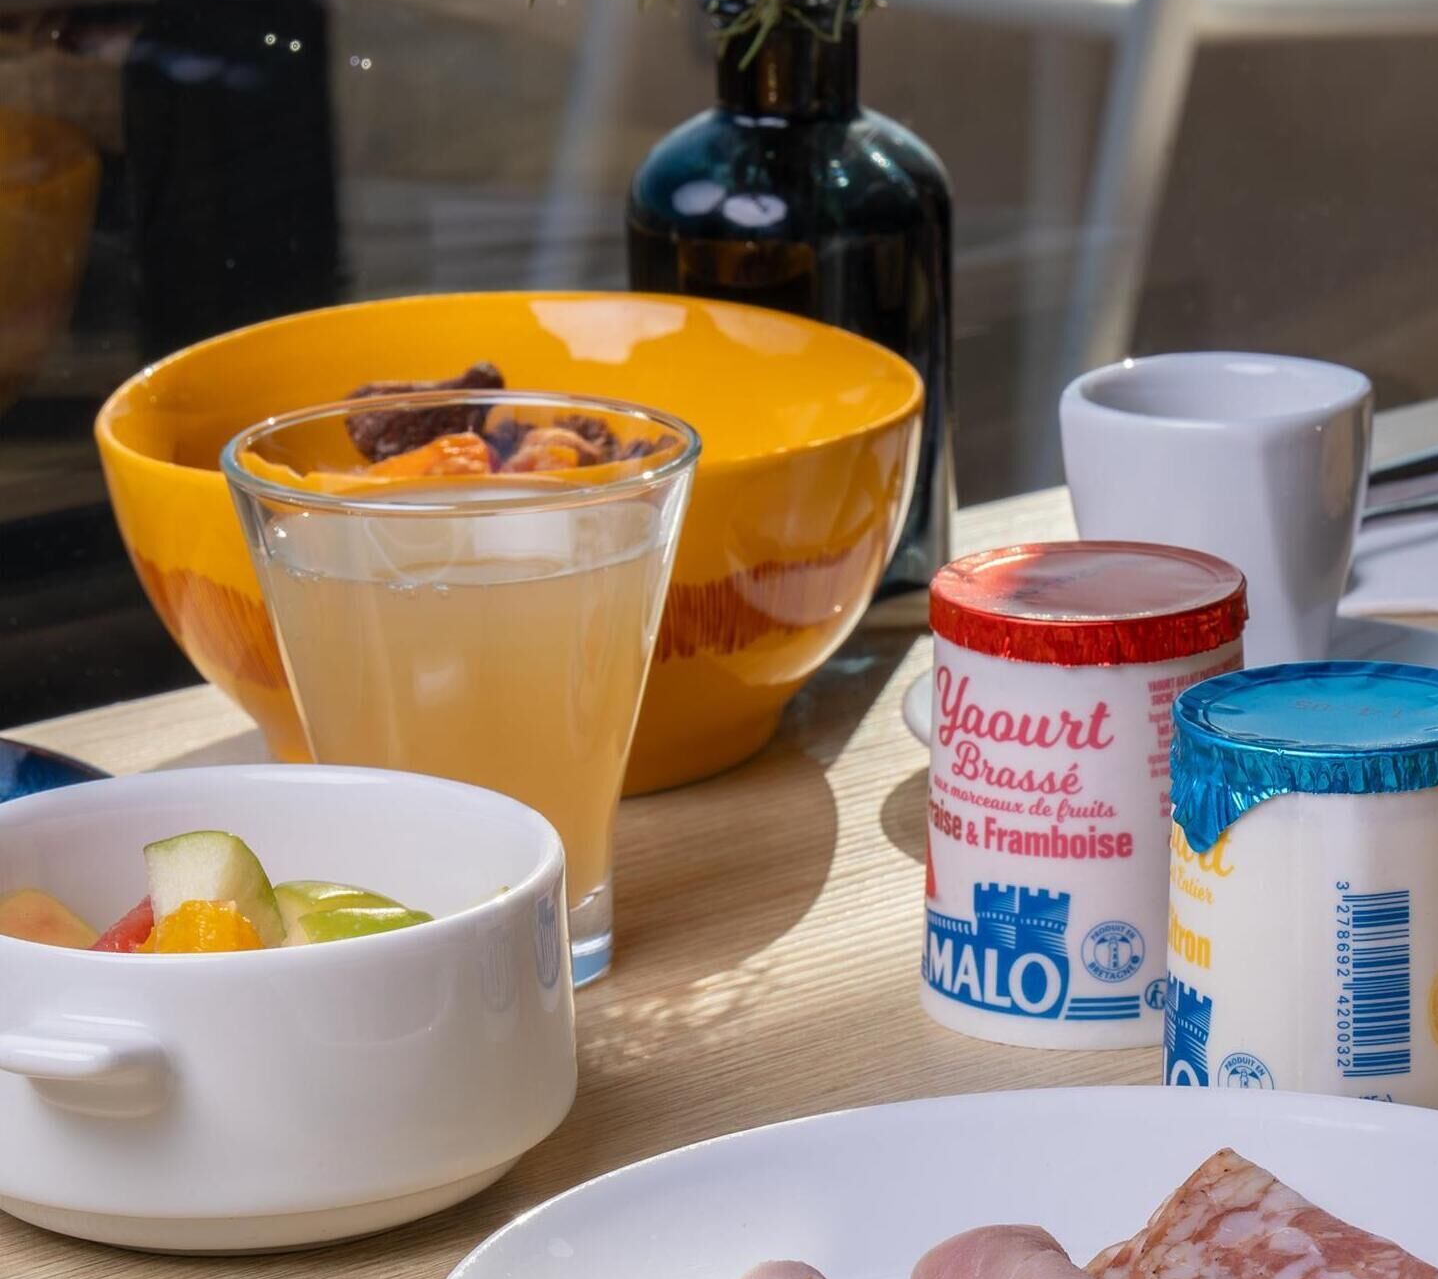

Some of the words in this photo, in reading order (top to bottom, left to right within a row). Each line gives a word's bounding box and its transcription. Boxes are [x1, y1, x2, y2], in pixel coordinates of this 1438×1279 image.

[937, 665, 1114, 750] Yaourt
[952, 739, 1083, 795] Brassé
[928, 796, 962, 840] raise
[966, 820, 979, 846] &
[984, 816, 1133, 859] Framboise
[951, 785, 1025, 814] morceaux
[1028, 796, 1053, 817] de
[1056, 797, 1118, 823] fruits
[1336, 881, 1349, 890] 3
[1090, 924, 1125, 941] PRODUIT
[1125, 929, 1136, 940] EN
[1336, 905, 1350, 977] 278692
[928, 931, 1062, 1014] MALO
[1088, 962, 1136, 980] BRETAGNE
[1336, 995, 1351, 1067] 420032
[1224, 1055, 1255, 1071] PRODUIT
[1255, 1064, 1265, 1077] EN
